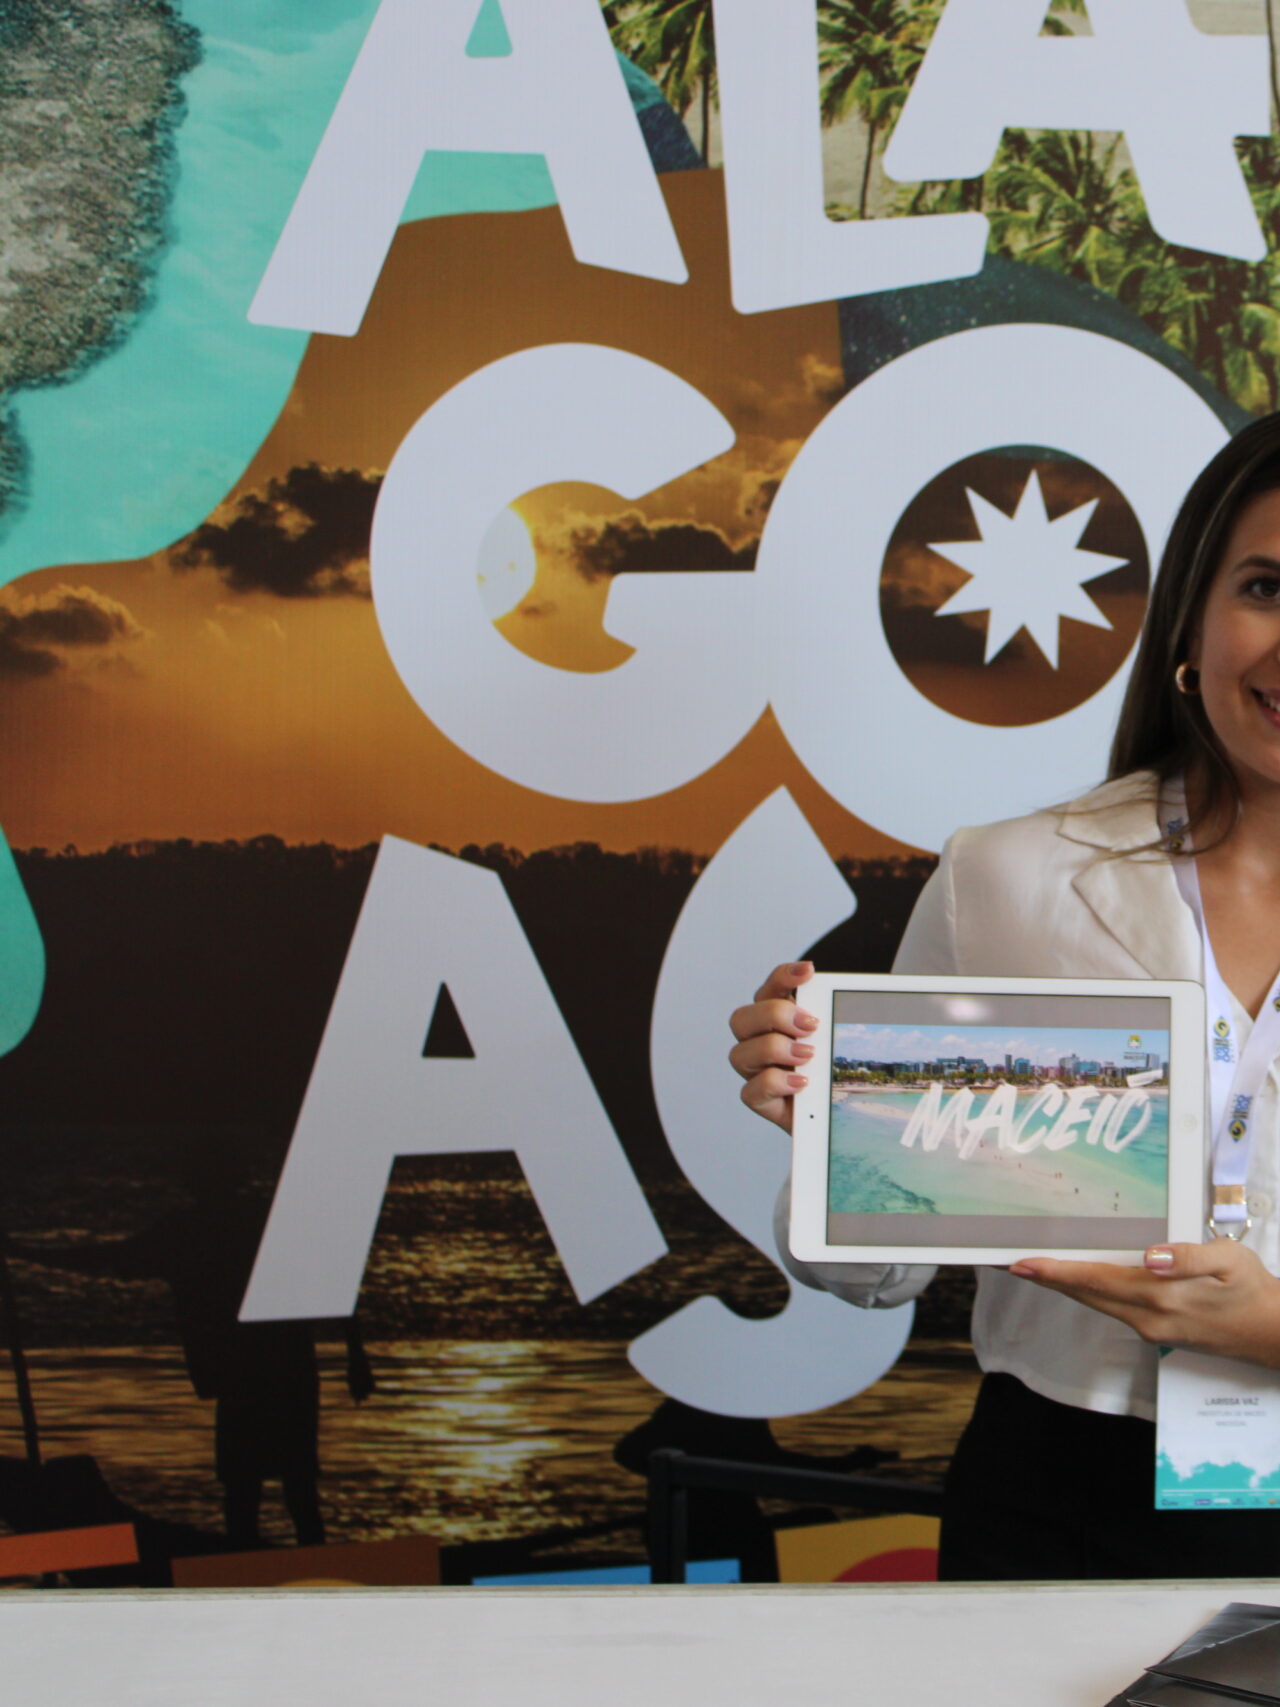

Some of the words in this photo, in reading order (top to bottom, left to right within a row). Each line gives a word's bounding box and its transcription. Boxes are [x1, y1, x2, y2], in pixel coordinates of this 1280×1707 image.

[370, 323, 1234, 856] GO
[899, 1068, 1164, 1160] MACEIÓ
[1204, 1397, 1240, 1406] LARISSA
[1241, 1397, 1260, 1406] VAZ
